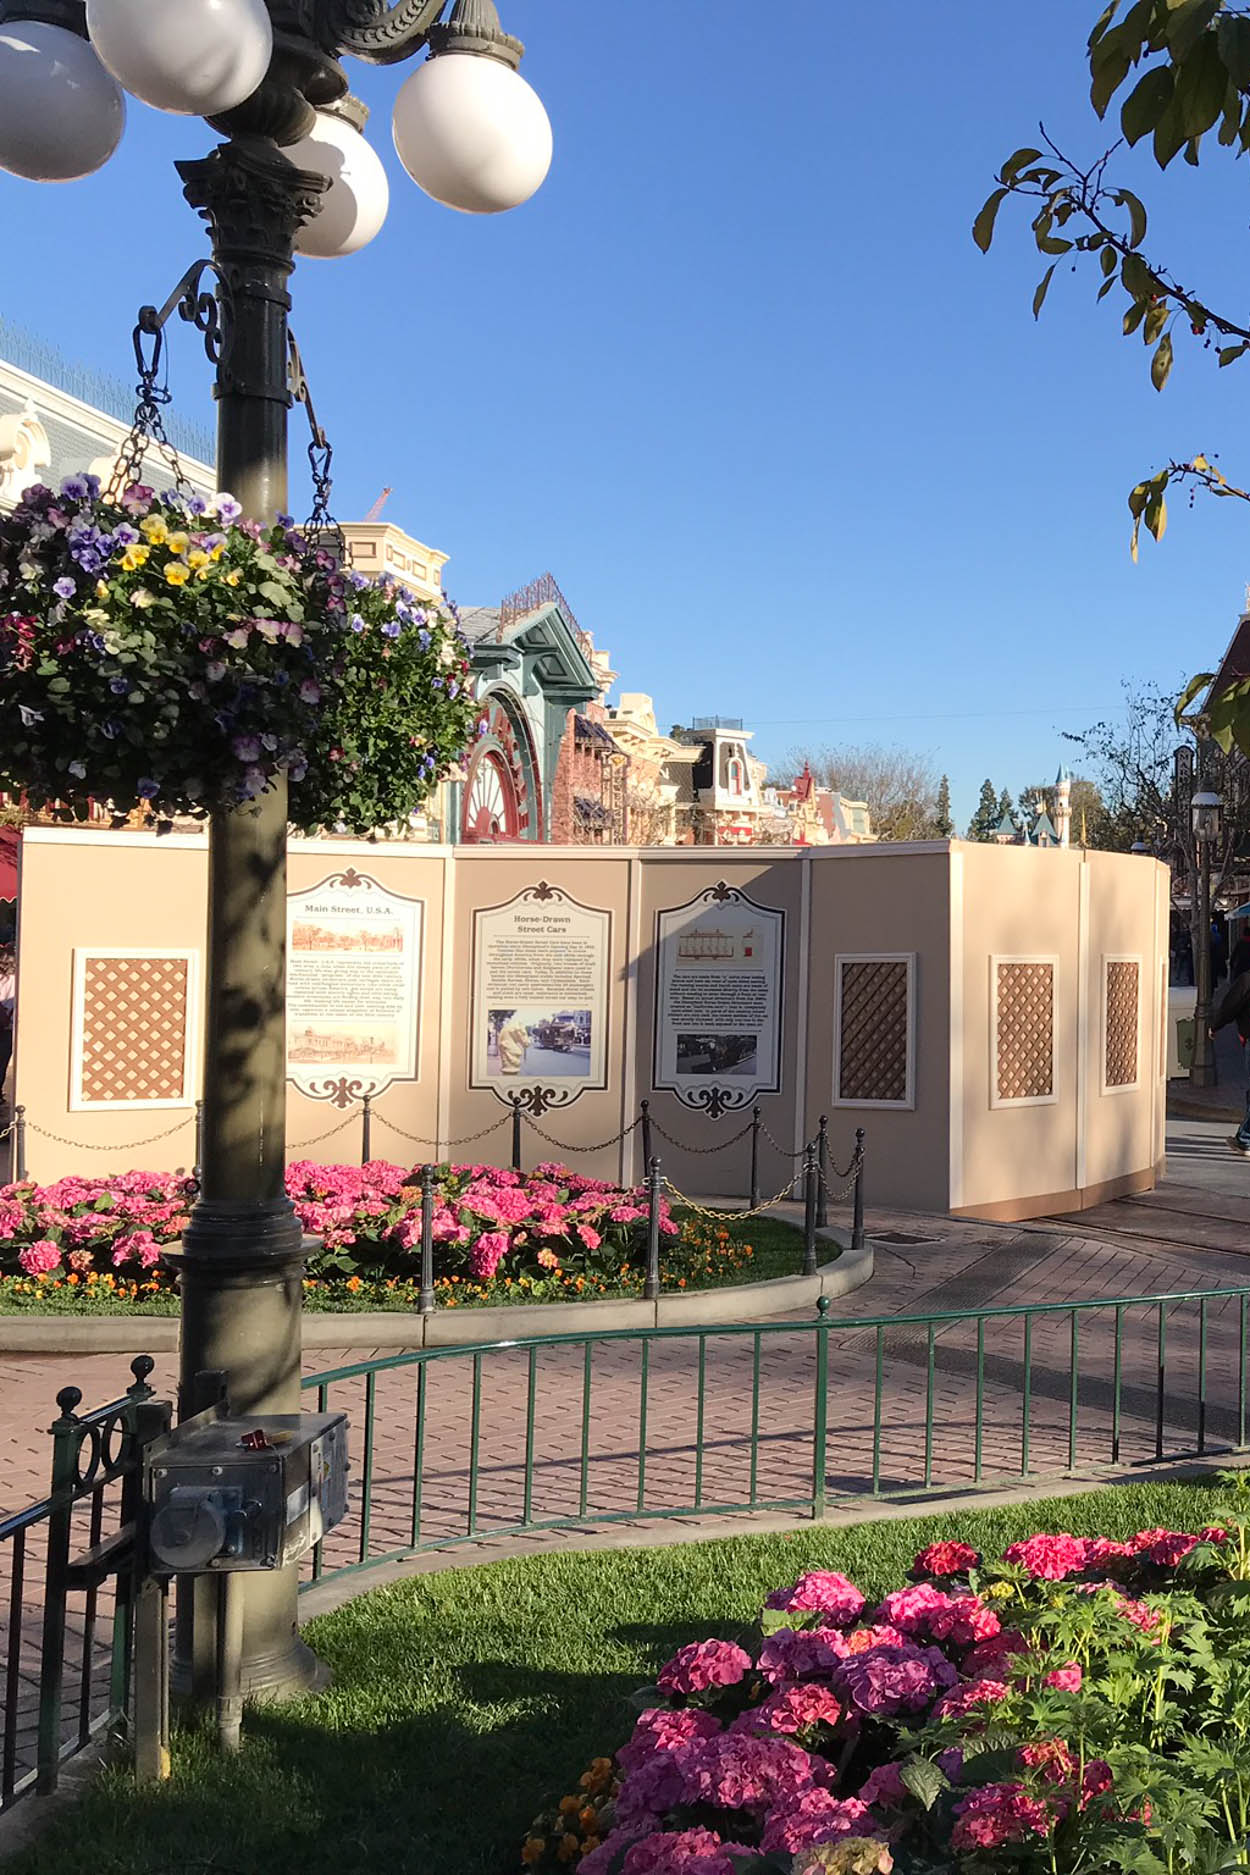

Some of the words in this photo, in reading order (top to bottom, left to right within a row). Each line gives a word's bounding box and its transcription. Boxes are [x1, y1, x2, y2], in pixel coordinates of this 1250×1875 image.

[305, 904, 328, 913] Main
[365, 906, 394, 915] U.S.A.
[513, 915, 571, 924] Horse-Drawn
[517, 926, 545, 934] Street
[546, 926, 567, 934] Cars
